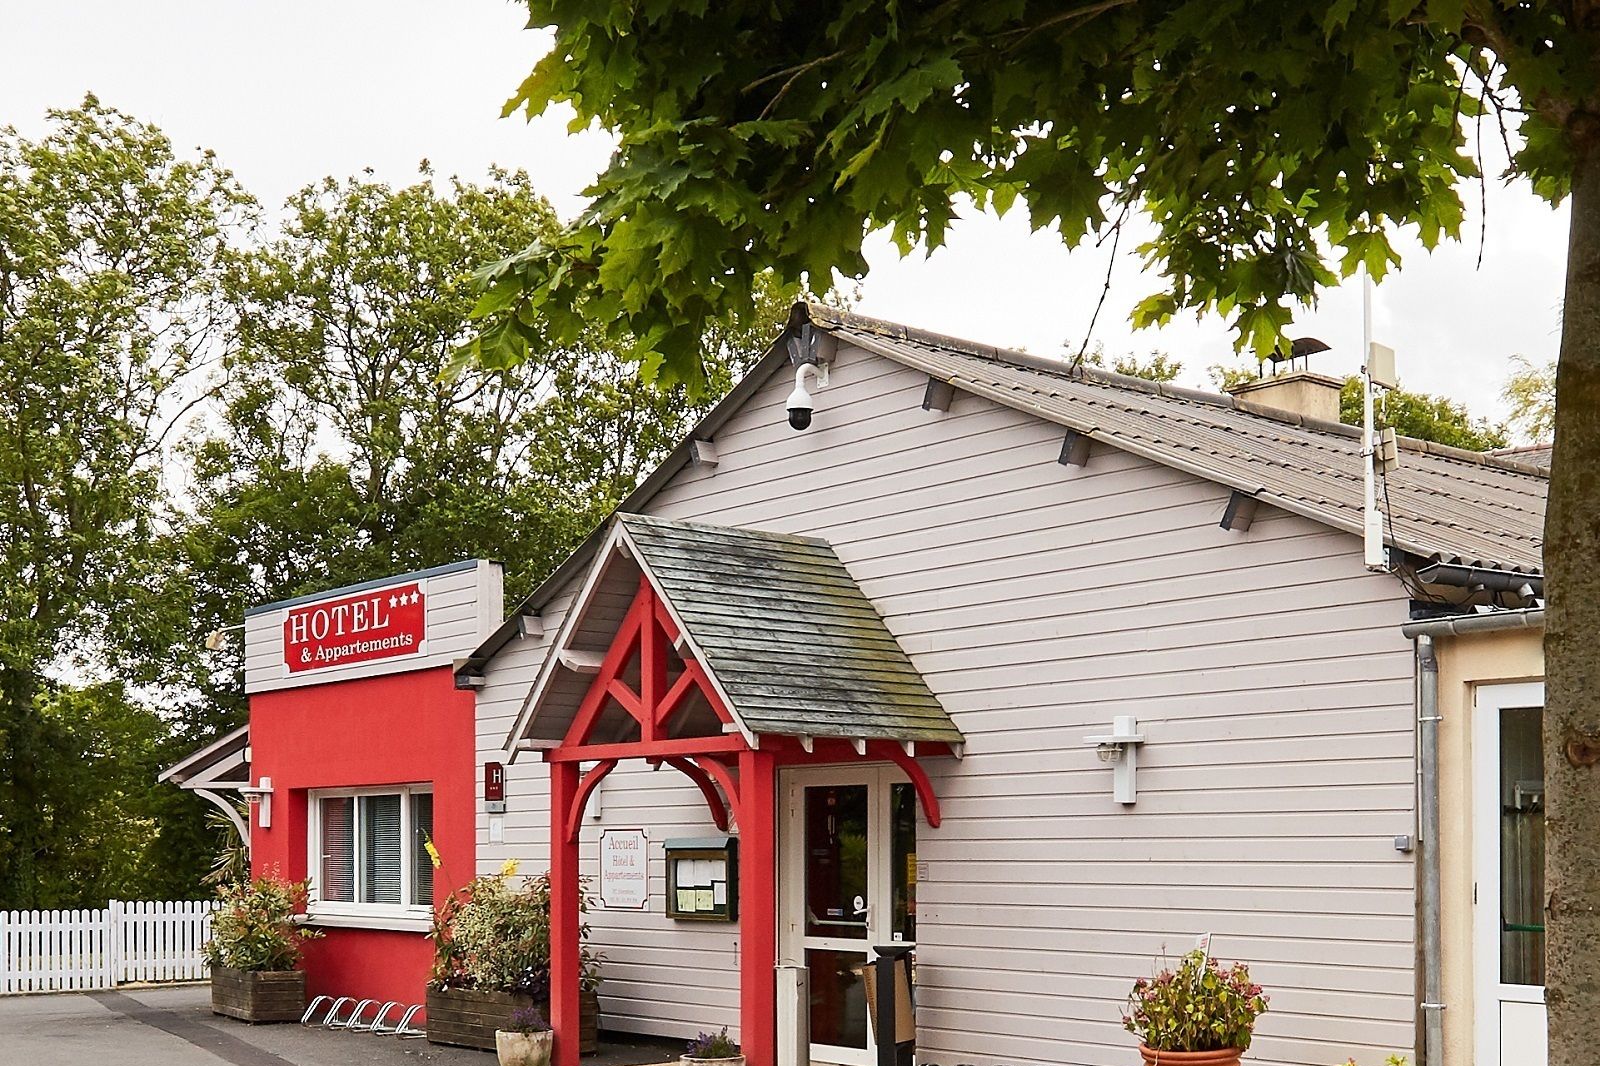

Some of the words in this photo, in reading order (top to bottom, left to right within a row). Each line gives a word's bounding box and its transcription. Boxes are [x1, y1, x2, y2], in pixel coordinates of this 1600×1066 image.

[289, 597, 390, 645] HOTEL
[300, 646, 312, 663] &
[314, 631, 413, 663] Appartements
[493, 769, 501, 783] H
[608, 835, 639, 850] Accueil
